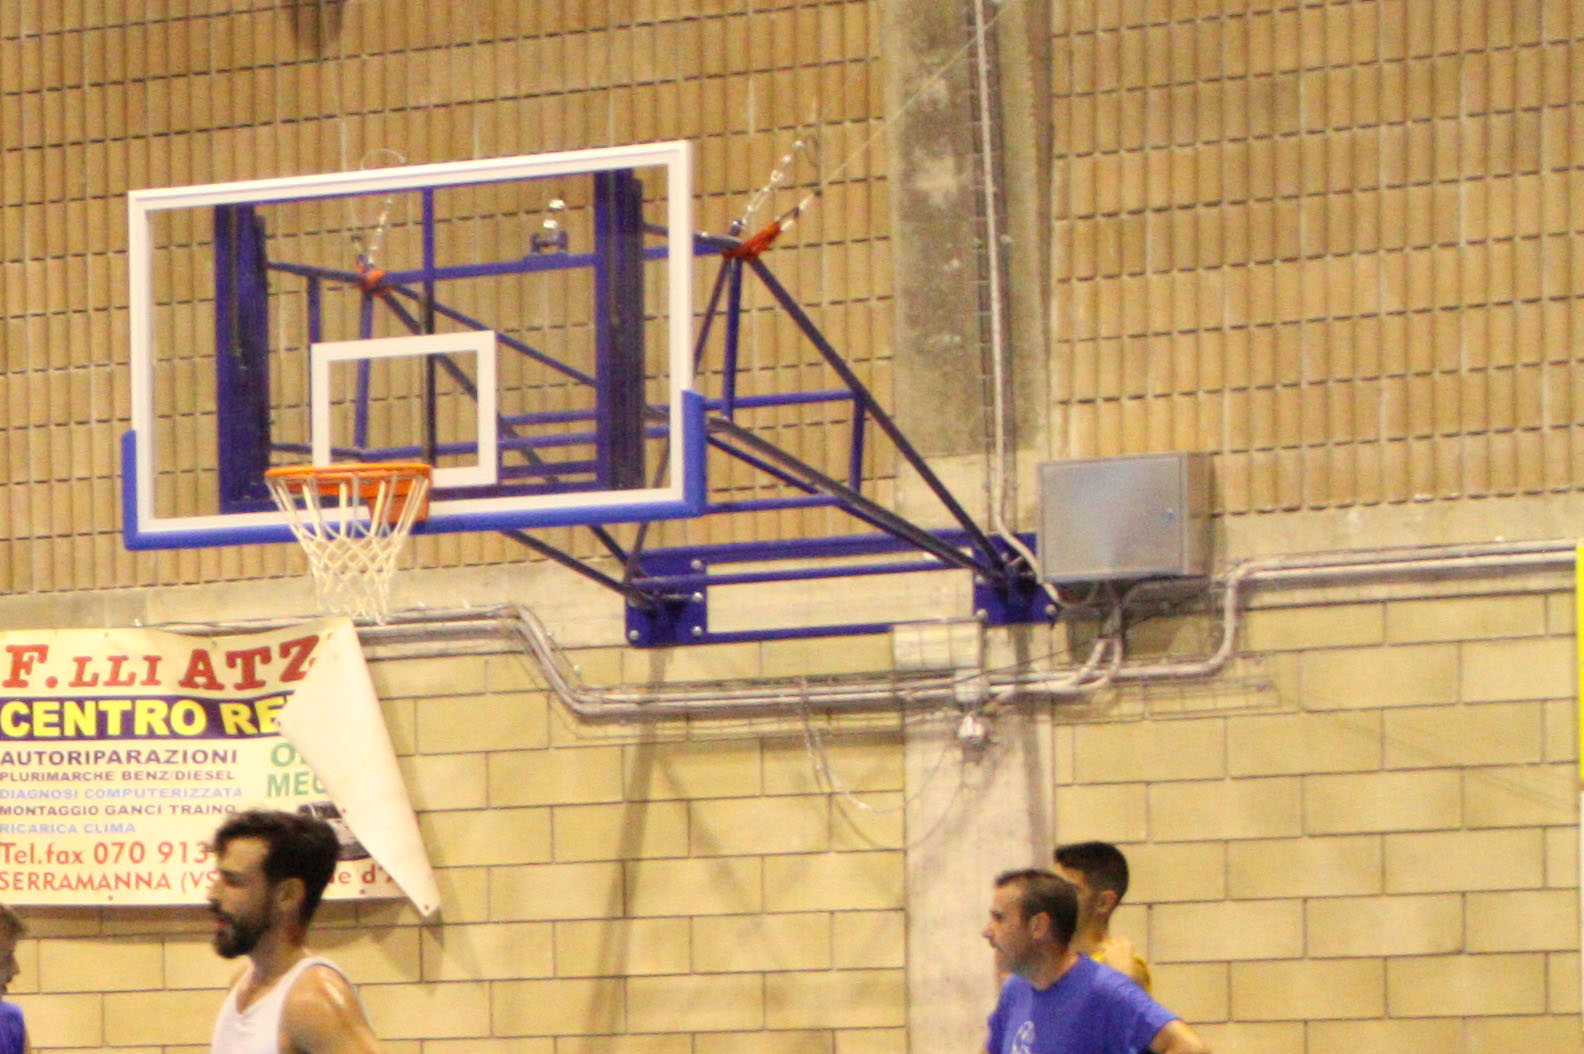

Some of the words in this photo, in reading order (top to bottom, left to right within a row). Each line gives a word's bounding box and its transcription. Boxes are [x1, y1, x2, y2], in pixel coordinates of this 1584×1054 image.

[2, 644, 162, 688] F.LLI
[0, 700, 208, 737] CENTRO
[0, 749, 238, 766] AUTORIPARAZIONI
[0, 770, 115, 783] PLURIMARCHE
[0, 787, 78, 800] DIAGNOSI
[84, 786, 243, 800] COMPUTERIZZATA
[0, 803, 99, 817] MONTAGGIO
[104, 803, 163, 816] GANCI
[84, 821, 137, 834] CLIMA
[93, 842, 145, 865] 070
